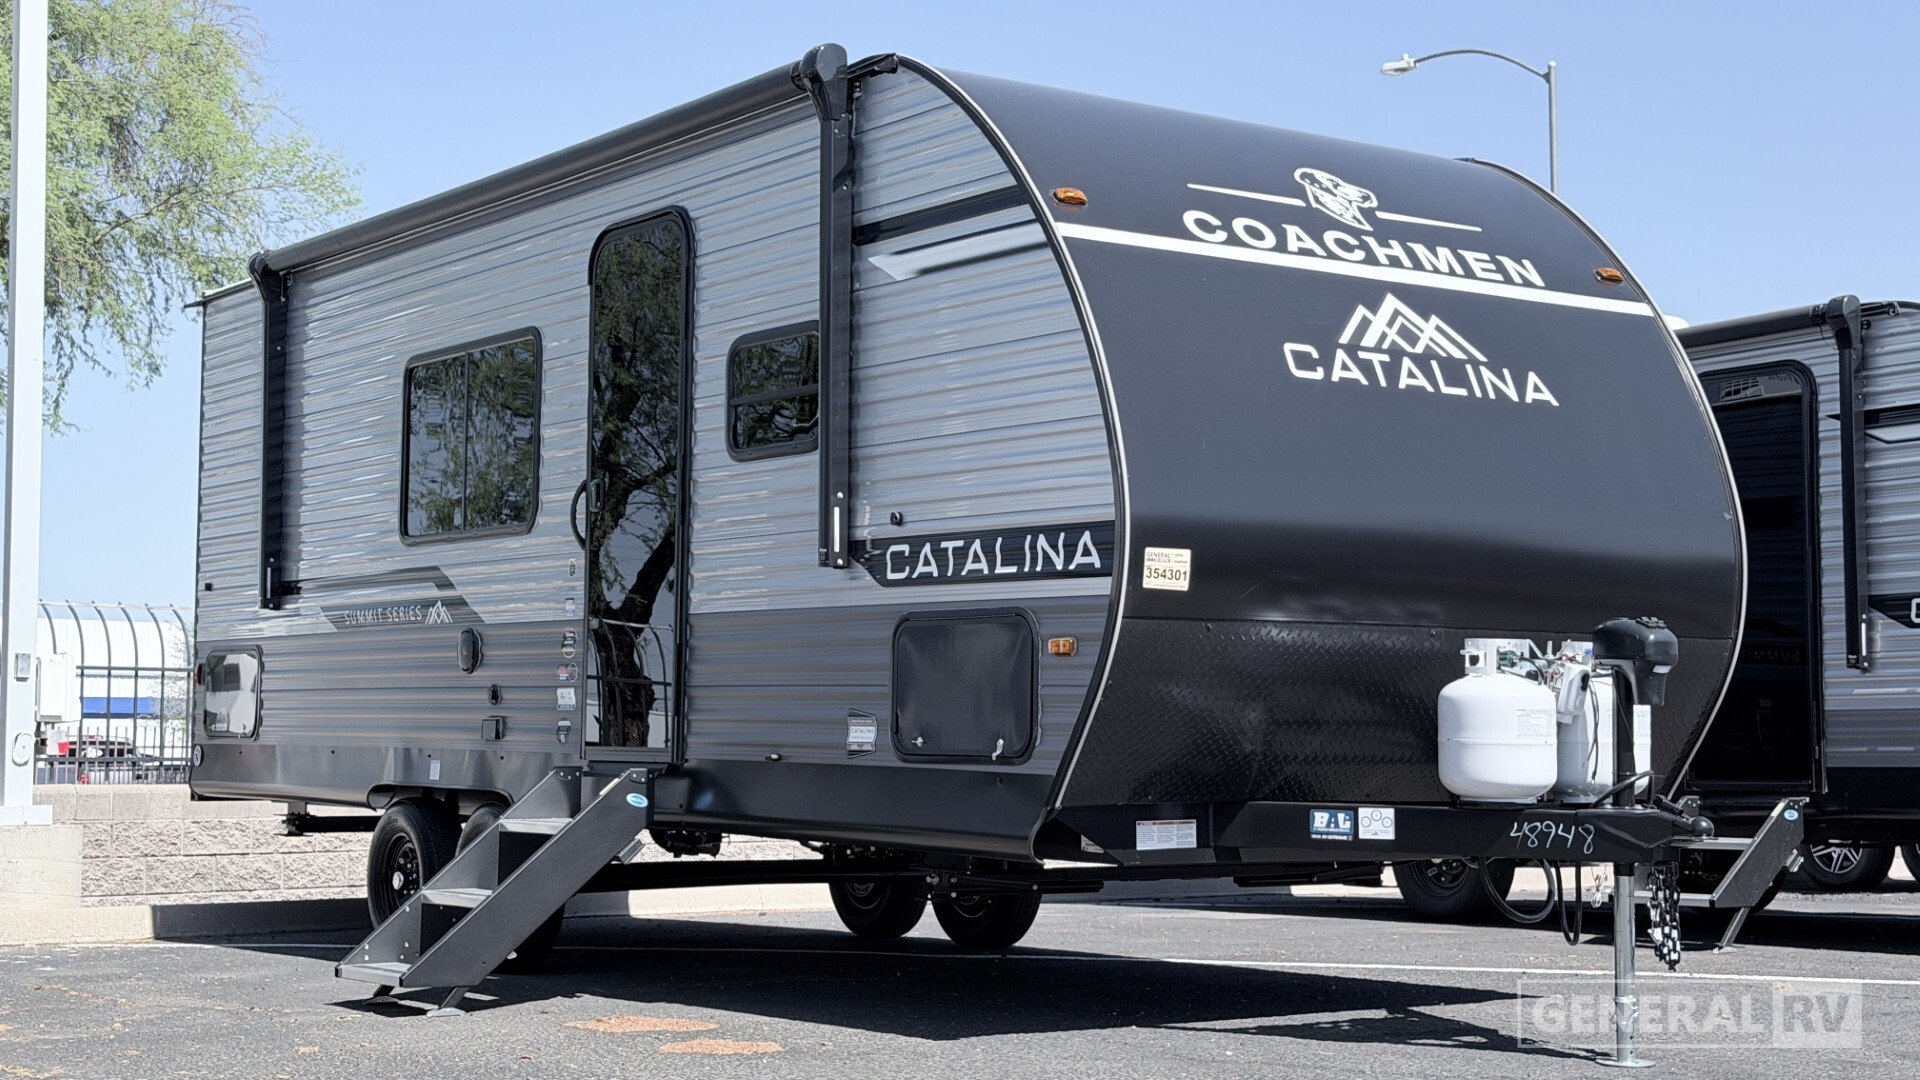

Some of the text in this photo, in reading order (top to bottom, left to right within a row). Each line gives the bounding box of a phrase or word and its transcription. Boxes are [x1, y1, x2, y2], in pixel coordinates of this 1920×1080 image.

[1183, 210, 1545, 287] COACHMEN
[1284, 342, 1559, 407] CATALINA
[886, 530, 1102, 580] CATALINA
[1145, 567, 1187, 581] 354301
[344, 605, 422, 625] SUMMIT SERIES
[1510, 821, 1595, 854] 48948
